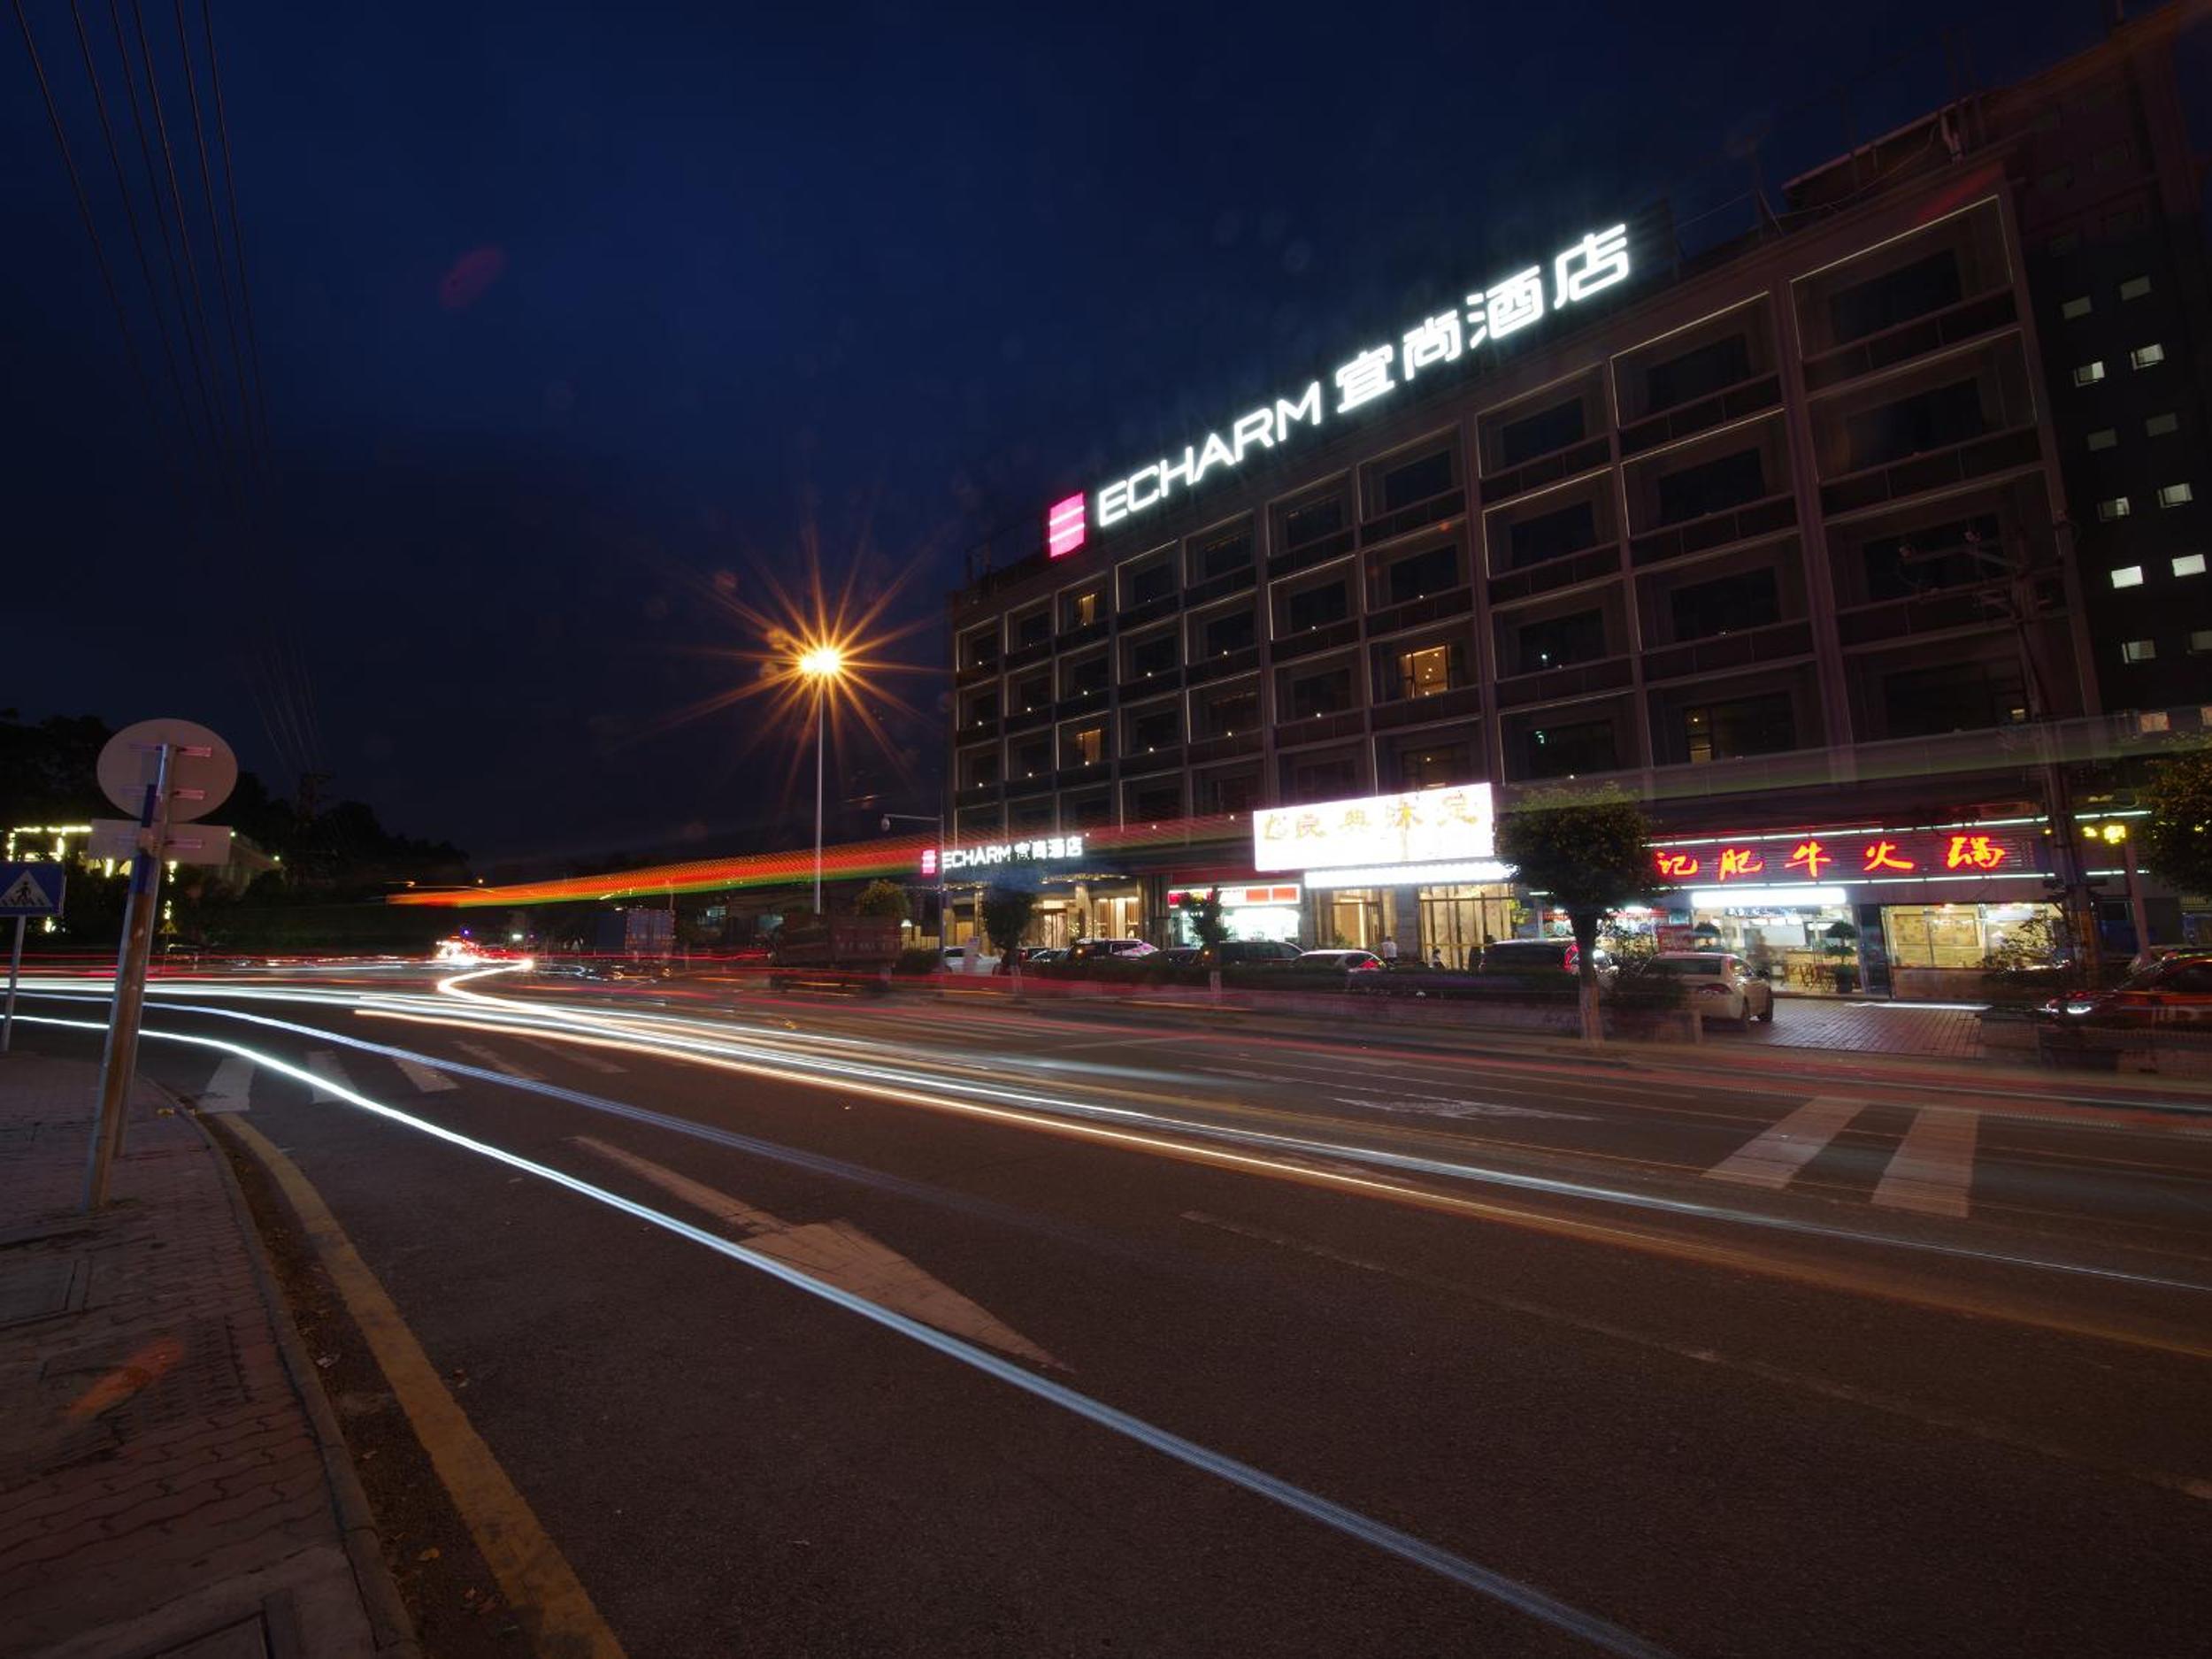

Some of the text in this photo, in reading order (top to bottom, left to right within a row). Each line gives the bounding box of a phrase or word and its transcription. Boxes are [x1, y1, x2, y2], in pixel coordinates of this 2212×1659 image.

[1098, 224, 1630, 526] ECHARM 宜尚酒店
[941, 845, 1011, 870] ECHARM
